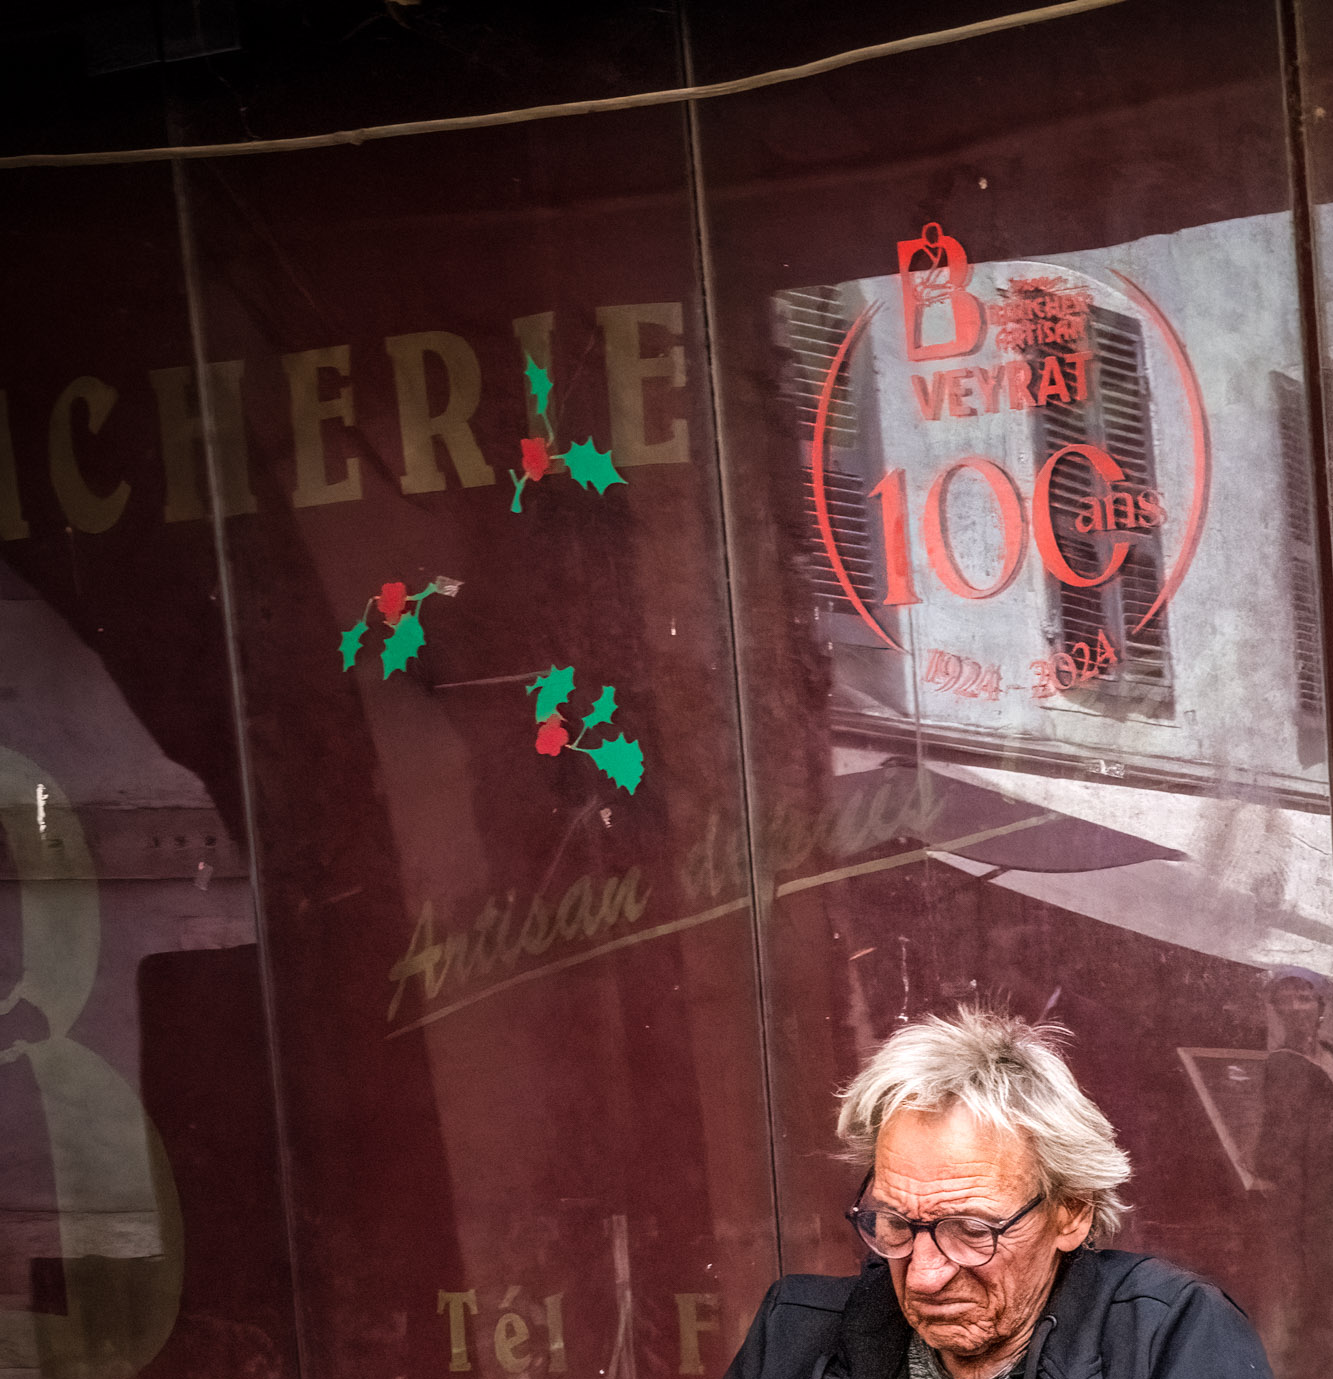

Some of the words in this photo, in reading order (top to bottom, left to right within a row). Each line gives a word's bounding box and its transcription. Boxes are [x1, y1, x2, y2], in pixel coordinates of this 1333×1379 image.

[911, 351, 1094, 421] VEYRAT
[1075, 484, 1170, 533] ans
[388, 866, 653, 1022] Artisan
